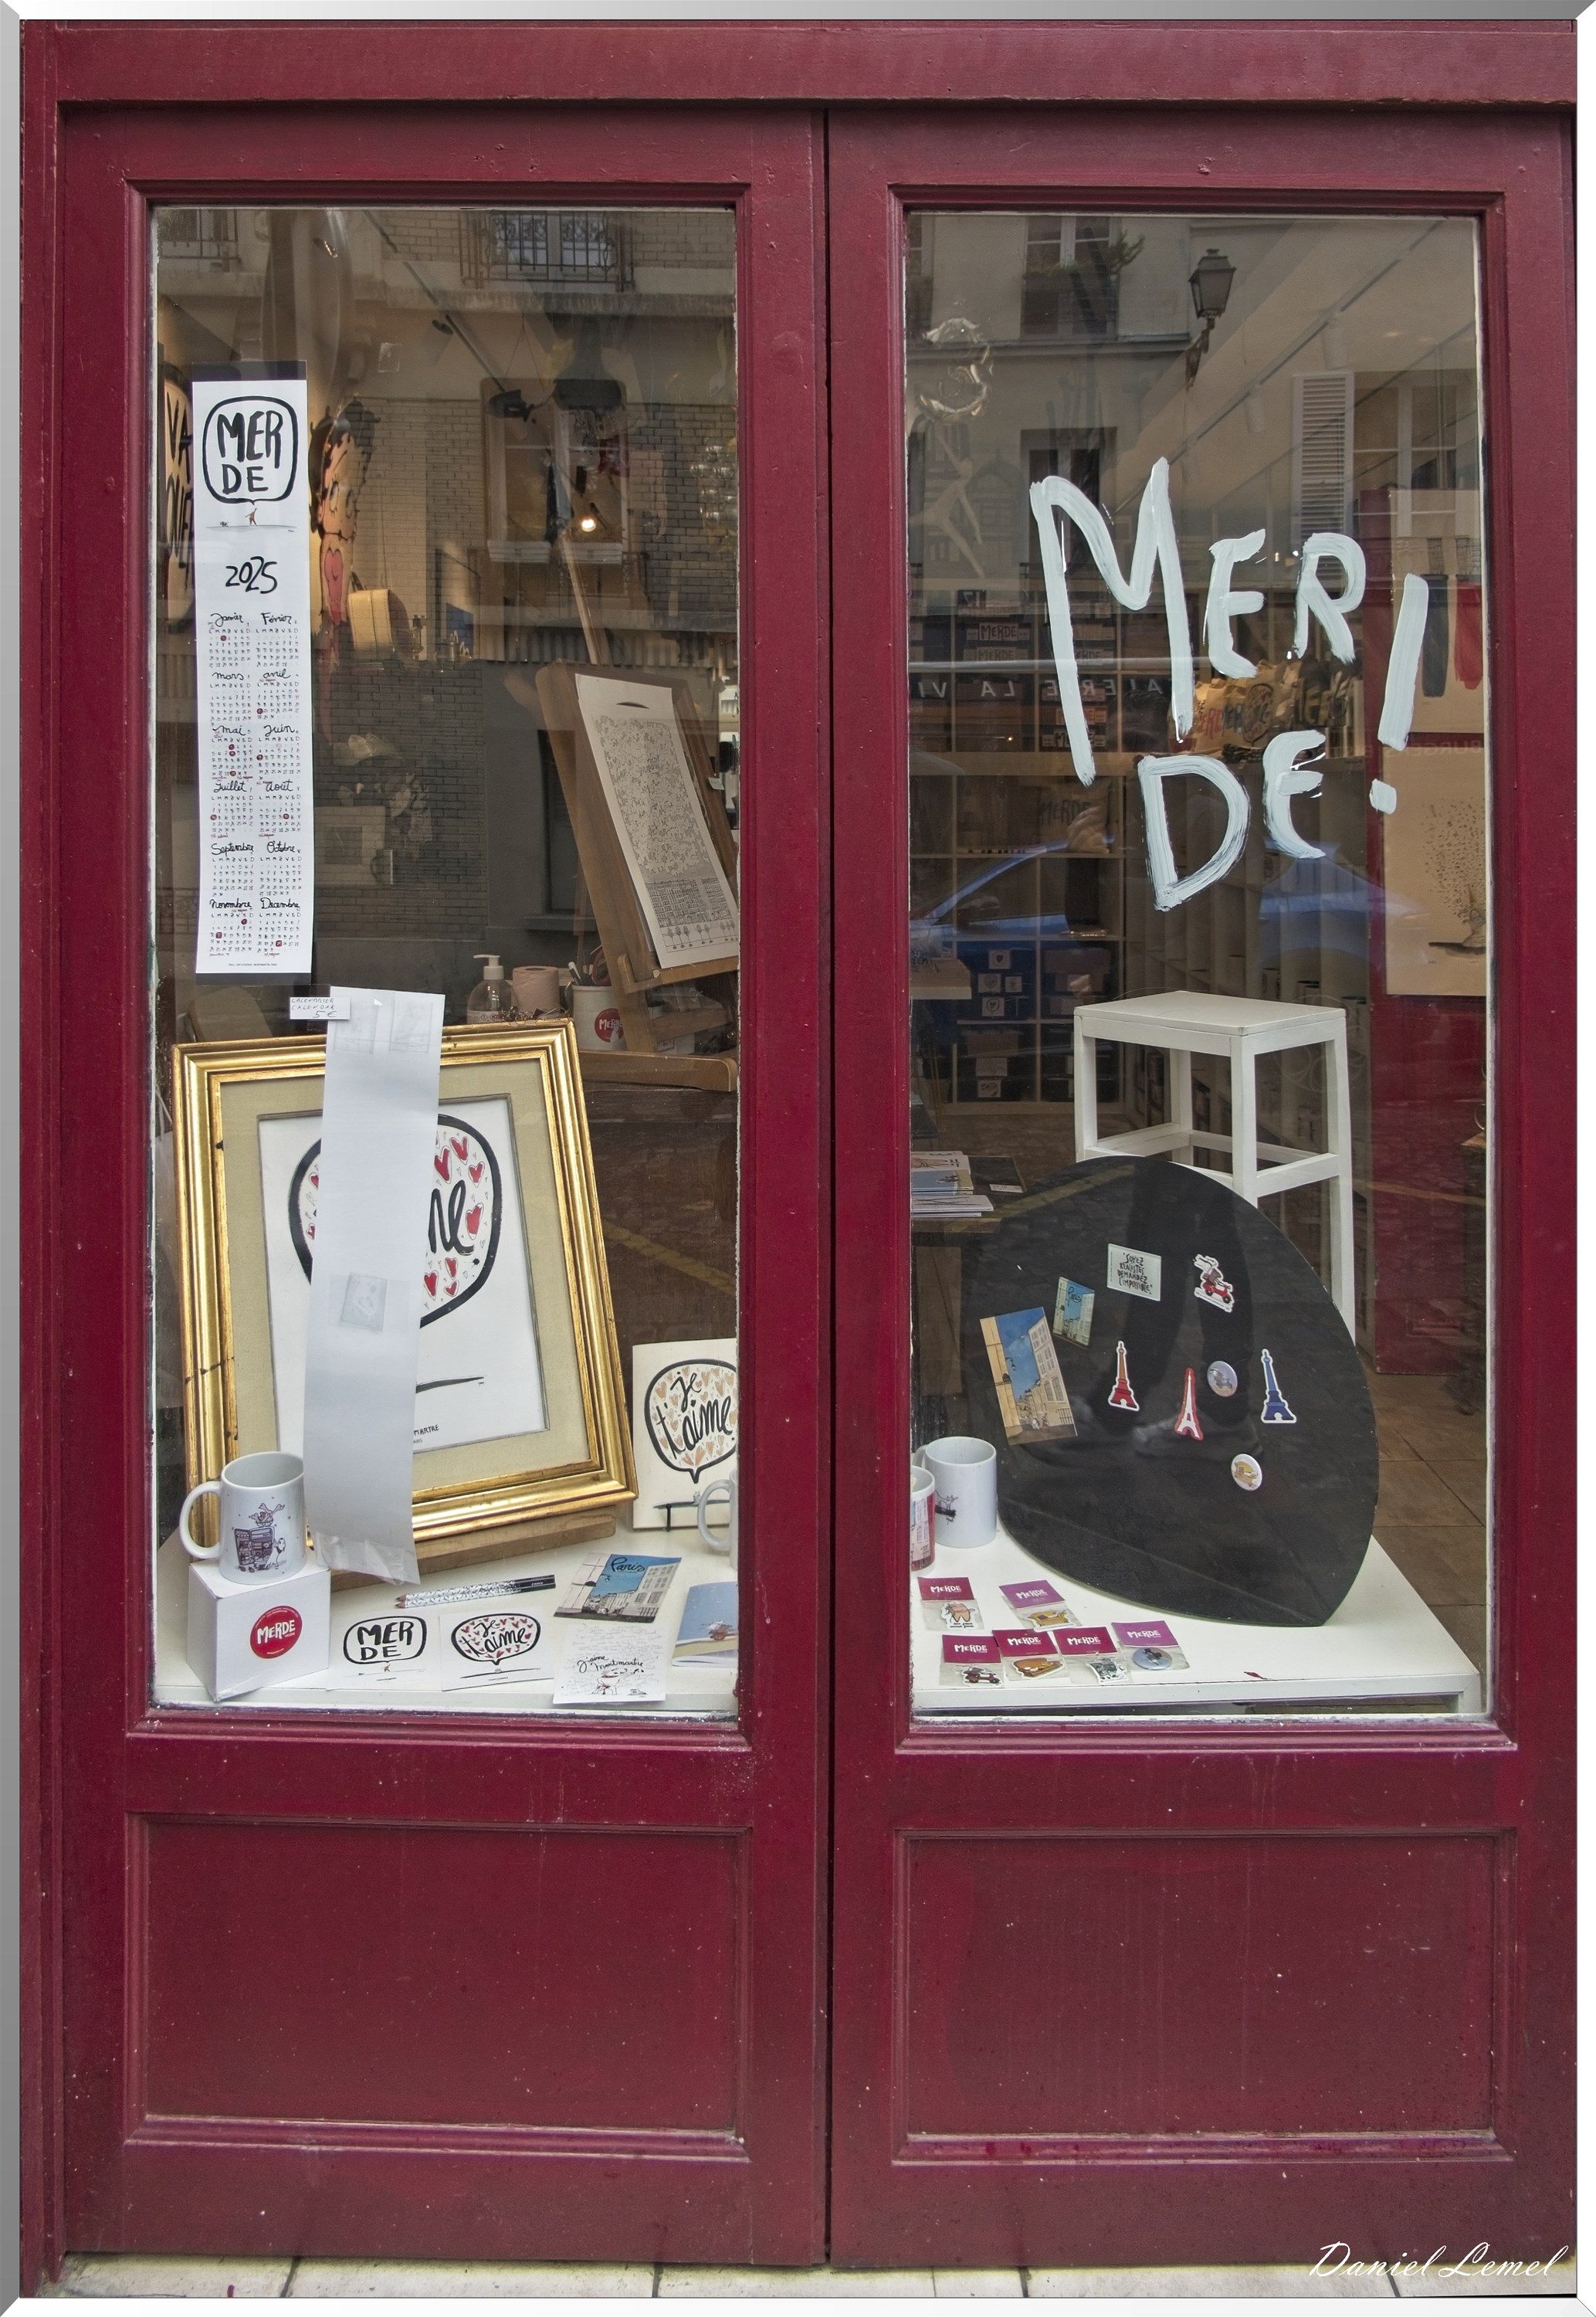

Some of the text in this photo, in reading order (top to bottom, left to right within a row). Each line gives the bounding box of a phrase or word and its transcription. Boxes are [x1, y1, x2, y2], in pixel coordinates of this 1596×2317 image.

[217, 410, 283, 469] MER
[222, 463, 269, 495] DE
[225, 556, 278, 594] 2025
[1029, 457, 1366, 789] MER
[611, 1556, 646, 1573] Paris
[257, 1620, 296, 1644] MERDE
[357, 1620, 415, 1646] MER
[360, 1645, 402, 1661] DE
